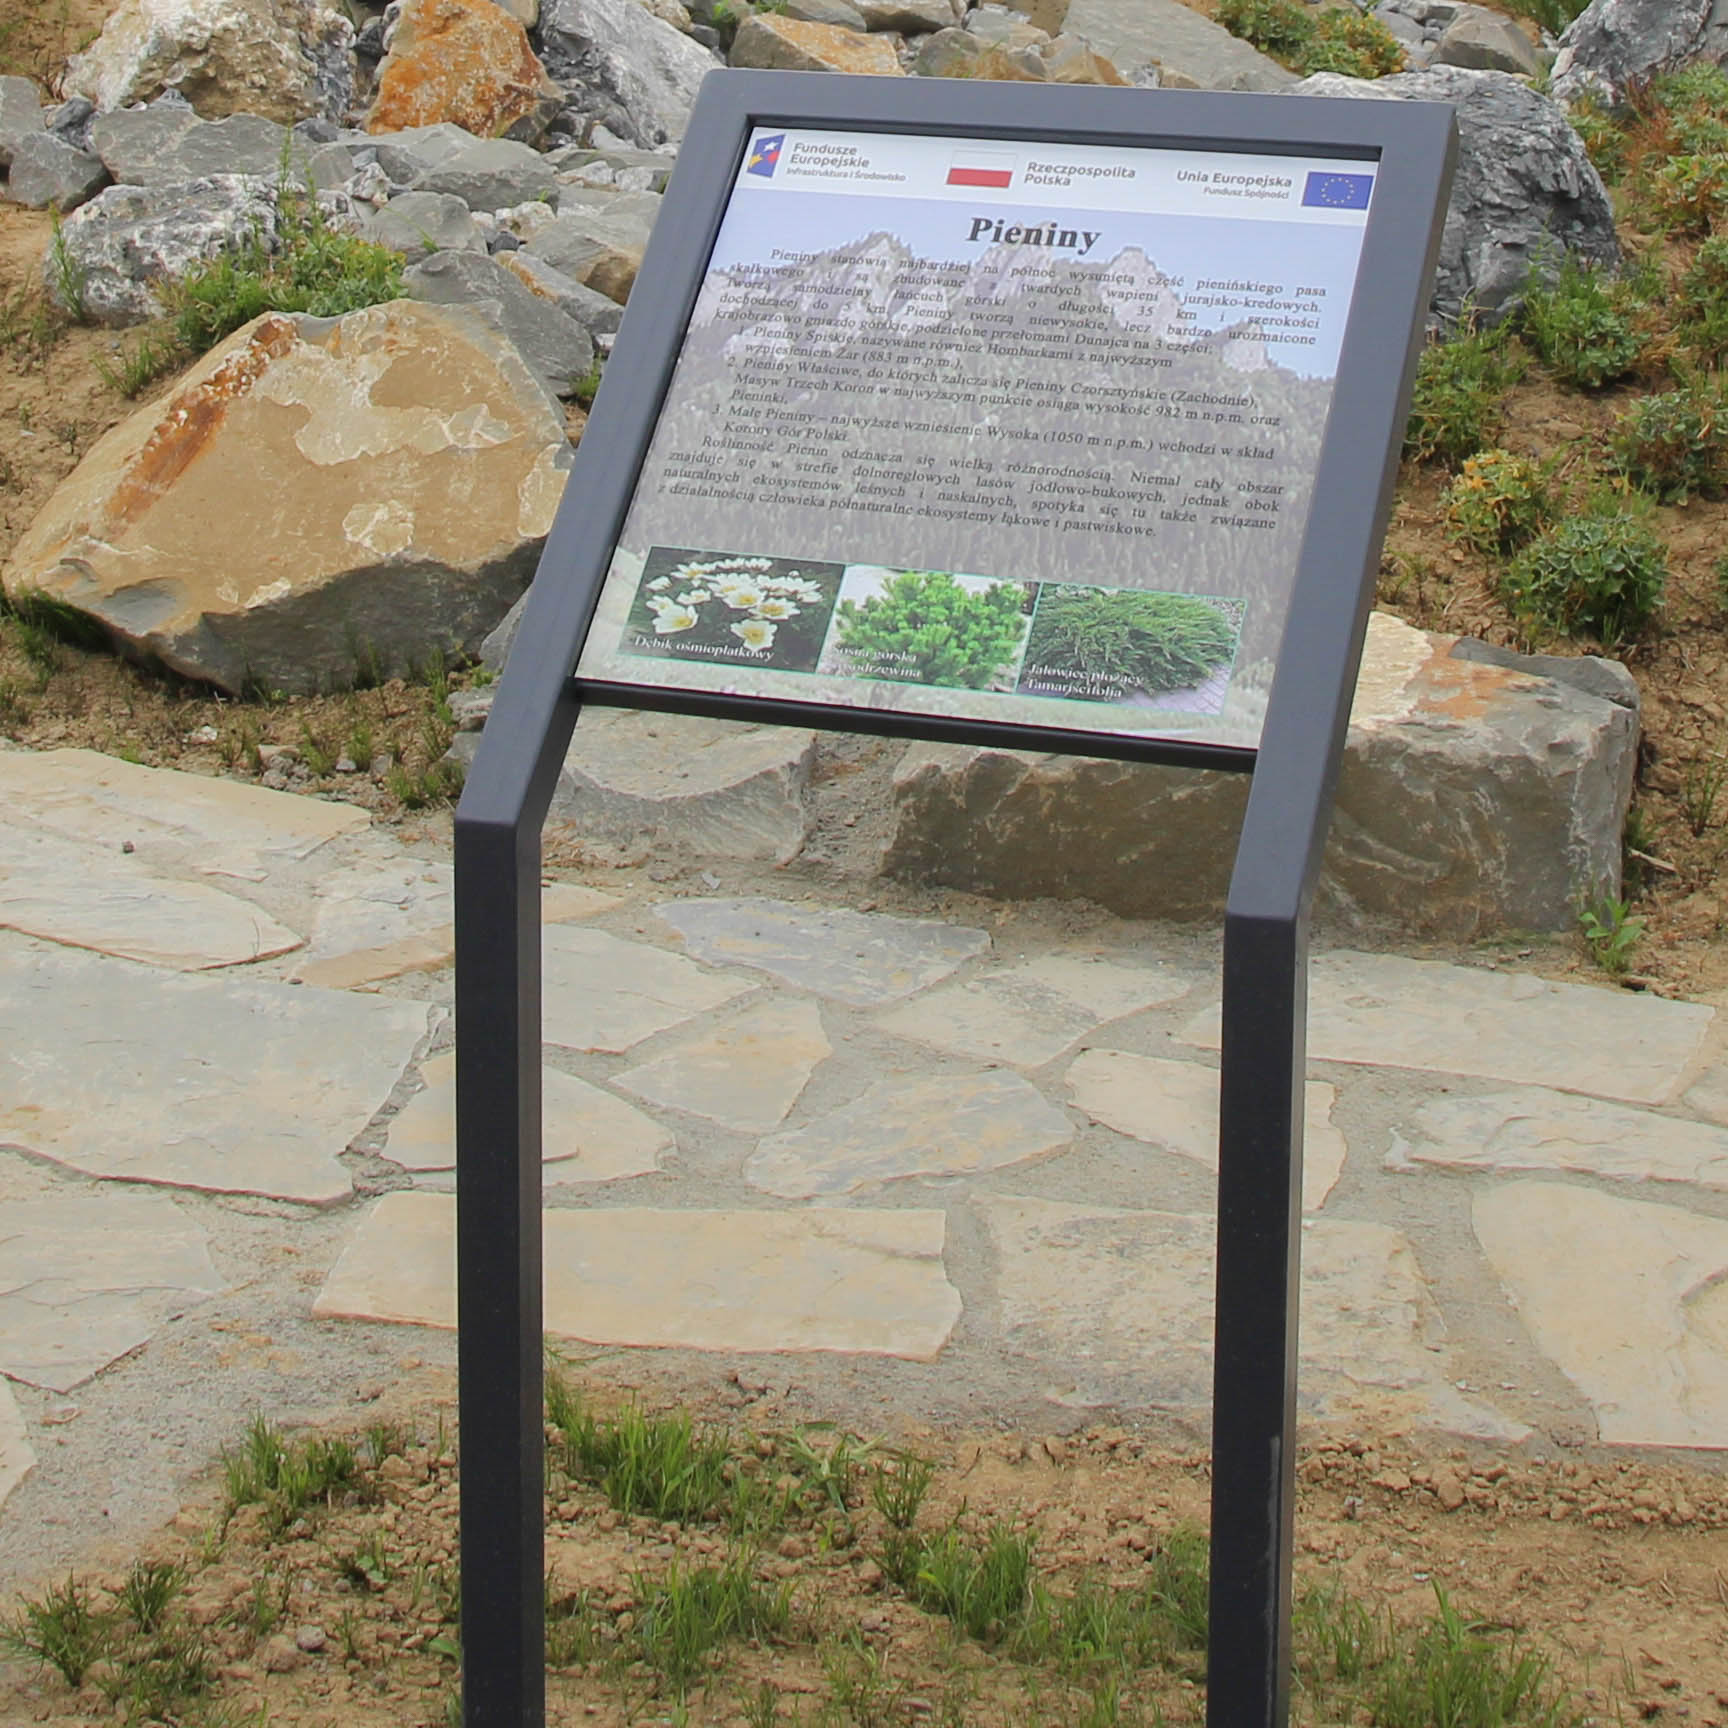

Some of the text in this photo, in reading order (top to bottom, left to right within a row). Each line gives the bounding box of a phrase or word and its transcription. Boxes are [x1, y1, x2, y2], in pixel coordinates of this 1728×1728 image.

[790, 154, 870, 169] Europejskie
[793, 143, 857, 155] Fundusze
[1024, 174, 1071, 186] Polska
[1027, 162, 1136, 179] Rzeczpospolita
[1176, 170, 1292, 188] Unia Europejska
[1203, 187, 1242, 196] Fundusz
[966, 218, 1101, 255] Pieniny
[770, 249, 819, 264] Pieniny
[830, 254, 887, 269] stanówią
[899, 259, 972, 275] najbardziej
[1010, 266, 1056, 278] północ
[1068, 272, 1135, 286] wysuniętą
[1147, 276, 1184, 288] część
[1195, 278, 1283, 295] pienińskiego
[1295, 287, 1326, 297] pasa
[855, 273, 868, 283] są
[893, 274, 965, 287] zbudowane
[1021, 282, 1082, 297] twardych
[1106, 290, 1159, 302] wapieni
[1180, 293, 1321, 314] jurajsko-kredowych.
[719, 292, 799, 310] dochodzącej
[812, 299, 829, 309] do
[905, 305, 954, 321] Pieniny
[969, 310, 1014, 325] tworzą
[1029, 315, 1108, 332] niewysokie,
[1124, 321, 1151, 332] lecz
[1167, 324, 1212, 336] bardzo
[1228, 331, 1316, 344] urozmaicone
[727, 277, 771, 292] Tworzą
[792, 284, 872, 299] samodzielny
[893, 289, 944, 301] łańcuch
[965, 294, 1007, 306] górski
[1058, 300, 1116, 314] długości
[1137, 306, 1154, 316] 35
[1176, 308, 1197, 319] km
[1247, 316, 1320, 328] szerokości
[714, 308, 802, 323] krajobrazowo
[804, 315, 856, 327] gniazdo
[915, 324, 989, 337] podzielone
[990, 330, 1070, 343] przełomami
[1074, 334, 1129, 349] Dunajca
[1134, 341, 1150, 349] na
[754, 326, 801, 342] Pieniny
[861, 337, 926, 349] nazywane
[929, 340, 982, 352] również
[987, 343, 1074, 359] Hombarkami
[861, 351, 893, 364] (883
[912, 357, 963, 371] n.p.m.),
[734, 373, 781, 388] Masyw
[785, 377, 830, 390] Trzech
[833, 381, 874, 393] Koron
[979, 394, 1032, 406] punkcie
[1036, 398, 1080, 412] osiąga
[1084, 403, 1151, 415] wysokość
[1155, 406, 1181, 417] 982
[1202, 412, 1244, 424] n.p.m.
[1250, 416, 1280, 425] oraz
[743, 358, 791, 374] Pieniny
[796, 362, 863, 379] Właściwe,
[867, 367, 884, 378] do
[887, 369, 938, 384] których
[942, 374, 987, 386] zalicza
[992, 377, 1011, 391] się
[1016, 378, 1065, 395] Pieniny
[1070, 383, 1166, 400] Czorsztyńskie
[1169, 390, 1257, 410] (Zachodnie),
[723, 421, 771, 438] Korony
[776, 426, 802, 437] Gór
[728, 405, 762, 417] Małe
[765, 408, 815, 425] Pieniny
[830, 415, 899, 429] najwyższe
[903, 421, 982, 435] wzniesienie
[986, 426, 1039, 440] Wysoka
[1042, 430, 1084, 444] (1050
[1104, 438, 1154, 452] n.p.m.)
[1158, 441, 1216, 454] wchodzi
[1237, 447, 1274, 459] skład
[668, 452, 724, 466] znajduje
[737, 456, 756, 470] się
[795, 461, 839, 474] strefie
[976, 476, 1015, 488] lasów
[1028, 480, 1166, 505] jodłowo-bukowych,
[1180, 493, 1229, 507] jednak
[1244, 499, 1280, 511] obok
[702, 436, 774, 451] Roślinność
[786, 443, 828, 456] Pienin
[841, 448, 903, 462] odznacza
[916, 454, 935, 468] się
[948, 457, 993, 473] wielką
[1130, 471, 1181, 485] Niemal
[1194, 478, 1224, 492] cały
[1237, 481, 1284, 494] obszar
[663, 467, 741, 484] naturalnych
[752, 474, 841, 491] ekosystemów
[855, 482, 906, 498] leśnych
[938, 491, 1017, 509] naskalnych,
[1031, 499, 1085, 514] spotyka
[1099, 504, 1118, 518] się
[1132, 506, 1146, 517] tu
[1160, 508, 1197, 521] także
[1210, 514, 1276, 529] związane
[758, 493, 826, 507] człowieka
[828, 498, 912, 514] półnaturalne
[917, 506, 996, 525] ekosystemy
[1001, 512, 1050, 527] łąkowe
[1062, 520, 1156, 536] pastwiskowe.
